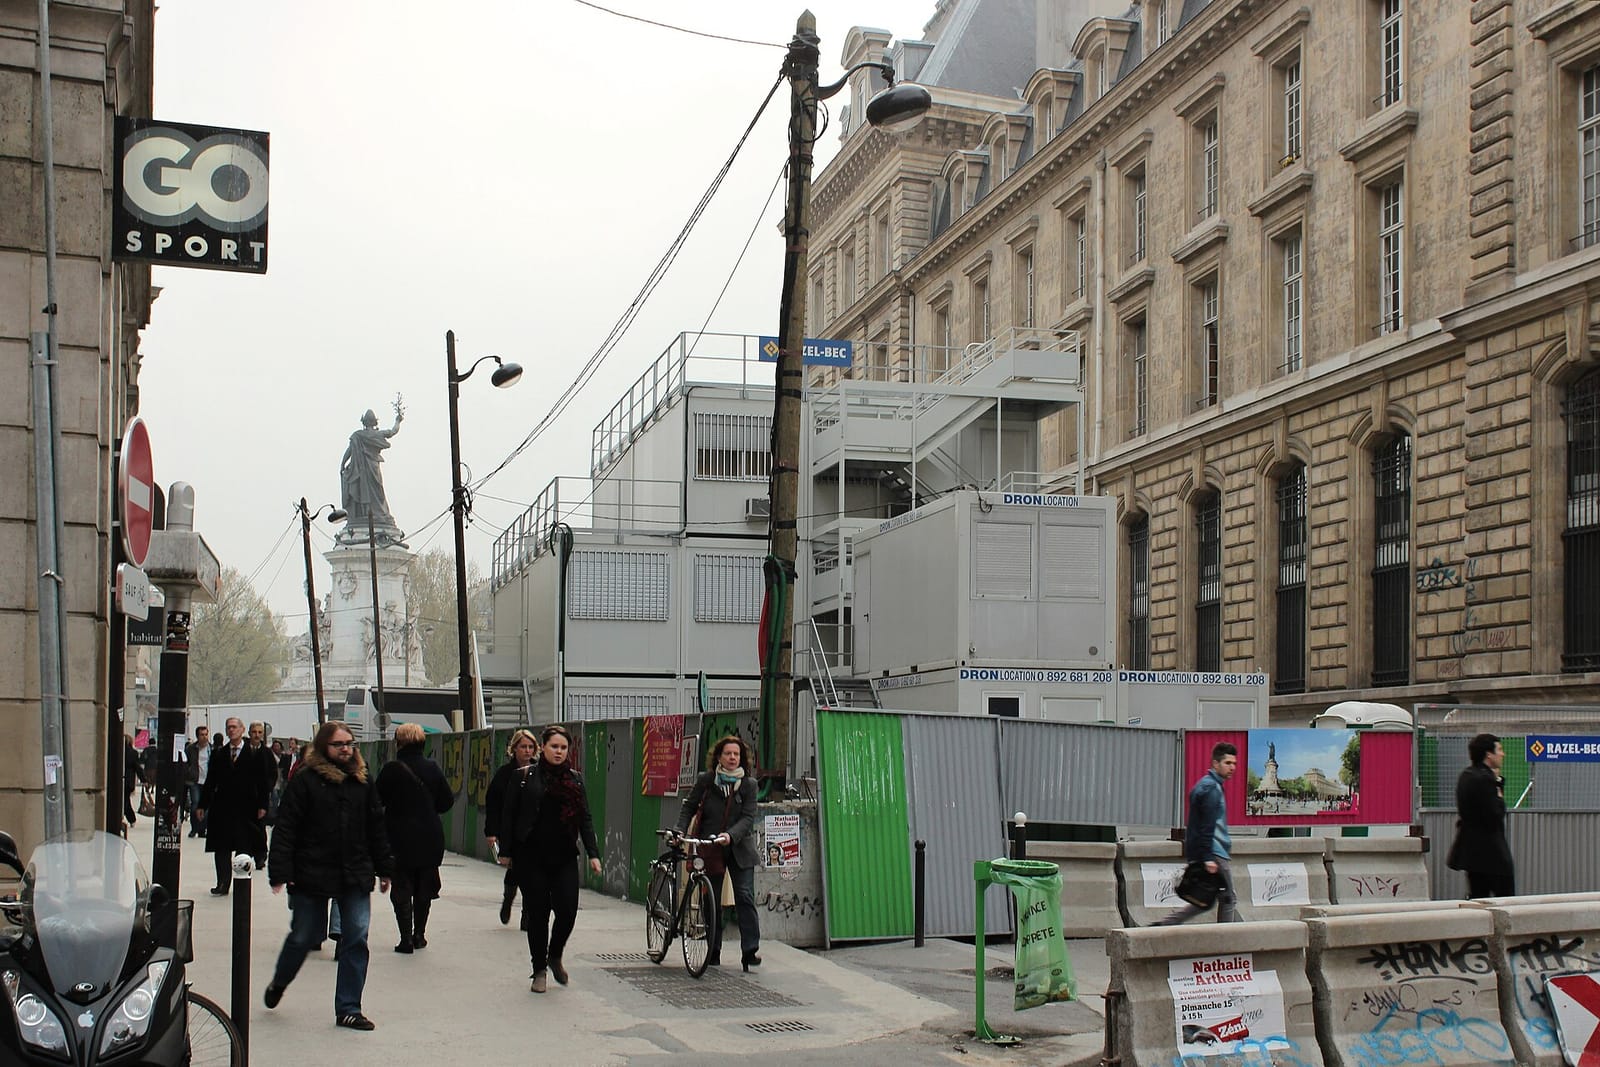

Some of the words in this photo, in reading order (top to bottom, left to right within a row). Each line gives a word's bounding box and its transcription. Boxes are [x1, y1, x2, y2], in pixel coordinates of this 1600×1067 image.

[122, 136, 269, 223] GO
[126, 230, 264, 263] SPORT
[802, 345, 847, 359] ZEL-BEC
[1003, 494, 1042, 505] DRON
[1043, 495, 1079, 507] LOCATION
[960, 670, 999, 680] DRON
[1000, 671, 1036, 681] LOCATION
[1037, 671, 1044, 681] 0
[1047, 672, 1067, 681] 892
[1069, 672, 1088, 682] 681
[1092, 673, 1113, 682] 208
[1119, 672, 1156, 682] DRON
[1157, 673, 1192, 683] LOCATION
[1193, 673, 1199, 683] 0
[1202, 674, 1221, 684] 892
[1224, 674, 1242, 684] 681
[1246, 675, 1264, 685] 208
[1192, 957, 1250, 974] Nathalie
[1195, 970, 1253, 986] Arthaud
[1181, 1001, 1222, 1013] Dimanche
[1223, 1000, 1233, 1008] 15
[1218, 1022, 1245, 1039] Zéni
